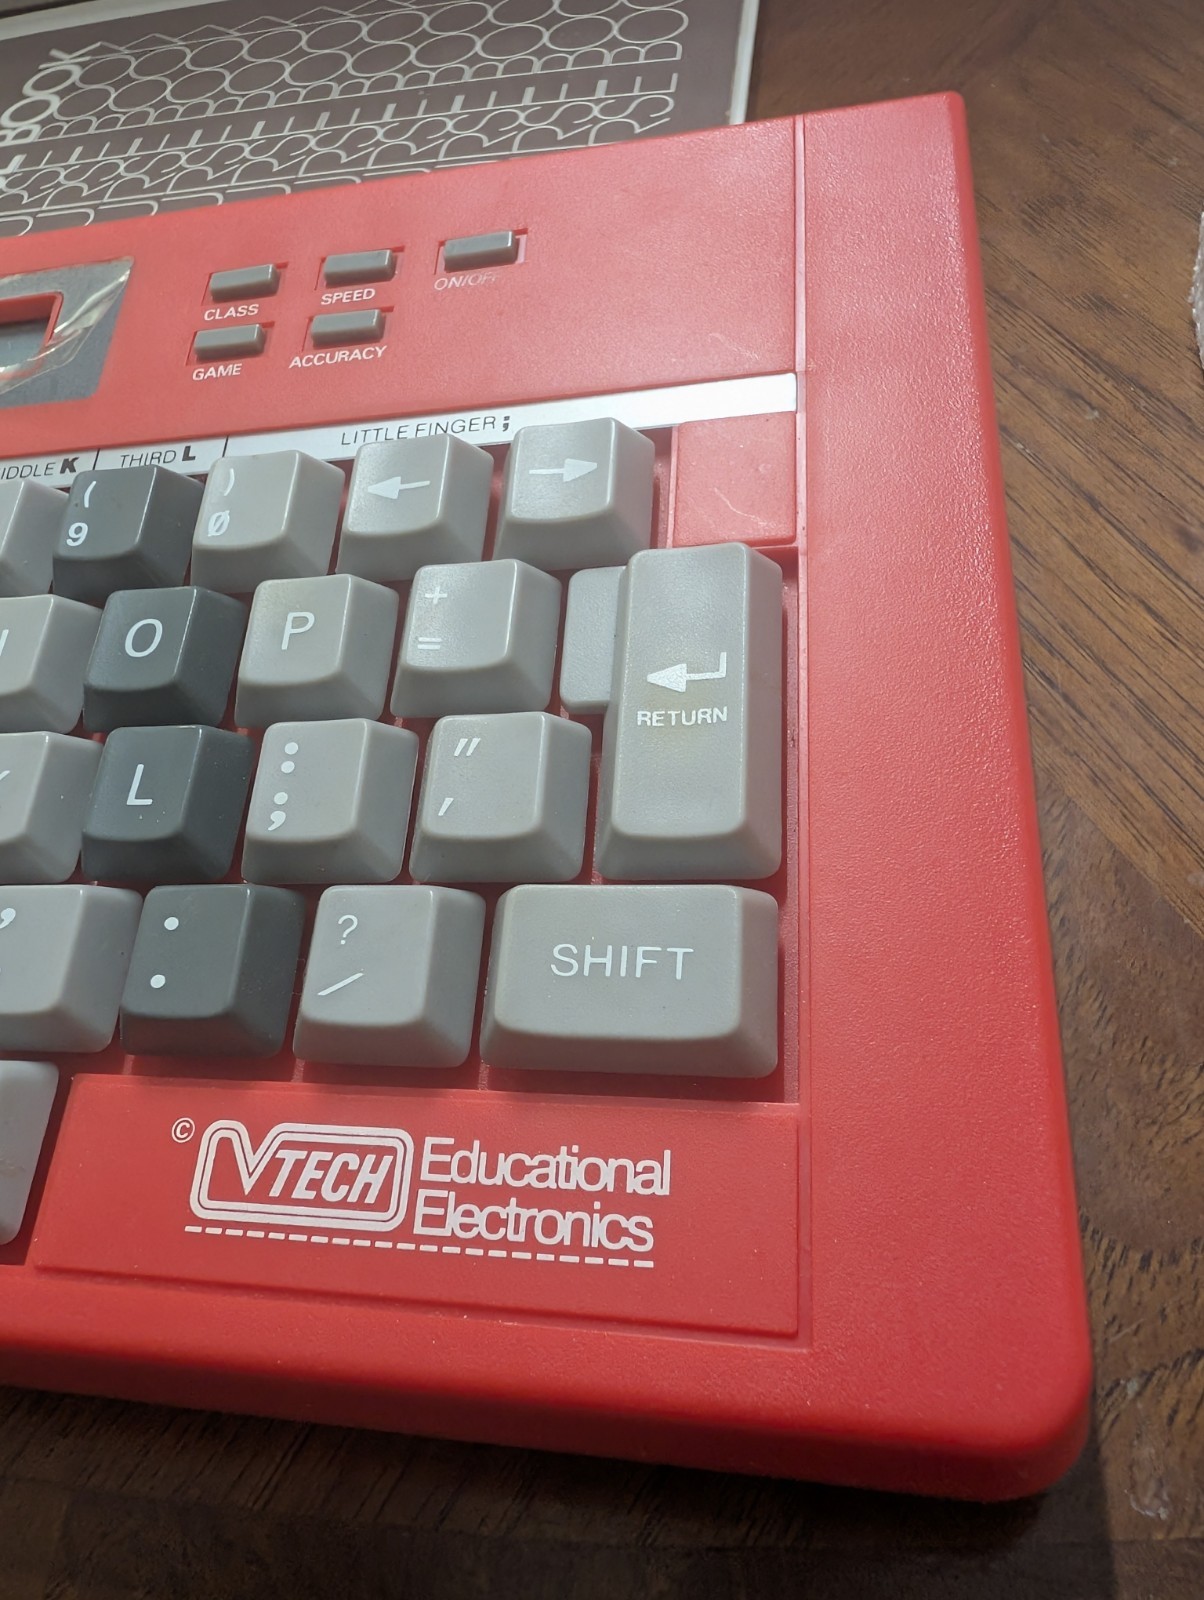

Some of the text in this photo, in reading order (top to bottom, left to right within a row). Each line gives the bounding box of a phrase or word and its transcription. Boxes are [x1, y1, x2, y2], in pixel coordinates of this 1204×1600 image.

[320, 288, 376, 306] SPEED
[203, 303, 259, 322] CLASS
[192, 363, 242, 381] GAME
[289, 345, 388, 370] ACCURACY
[341, 424, 409, 446] LITTLE
[415, 415, 496, 438] FINGER
[59, 456, 80, 474] K
[120, 445, 196, 468] THIRD L
[83, 480, 97, 508] (
[223, 467, 236, 497] )
[66, 522, 89, 547] 9
[124, 618, 163, 658] O
[281, 611, 315, 651] P
[636, 706, 728, 727] RETURN
[126, 764, 153, 806] L
[337, 914, 358, 946] ?
[550, 943, 695, 980] SHIFT
[420, 1136, 671, 1195] Educational
[413, 1188, 654, 1252] Electronics
